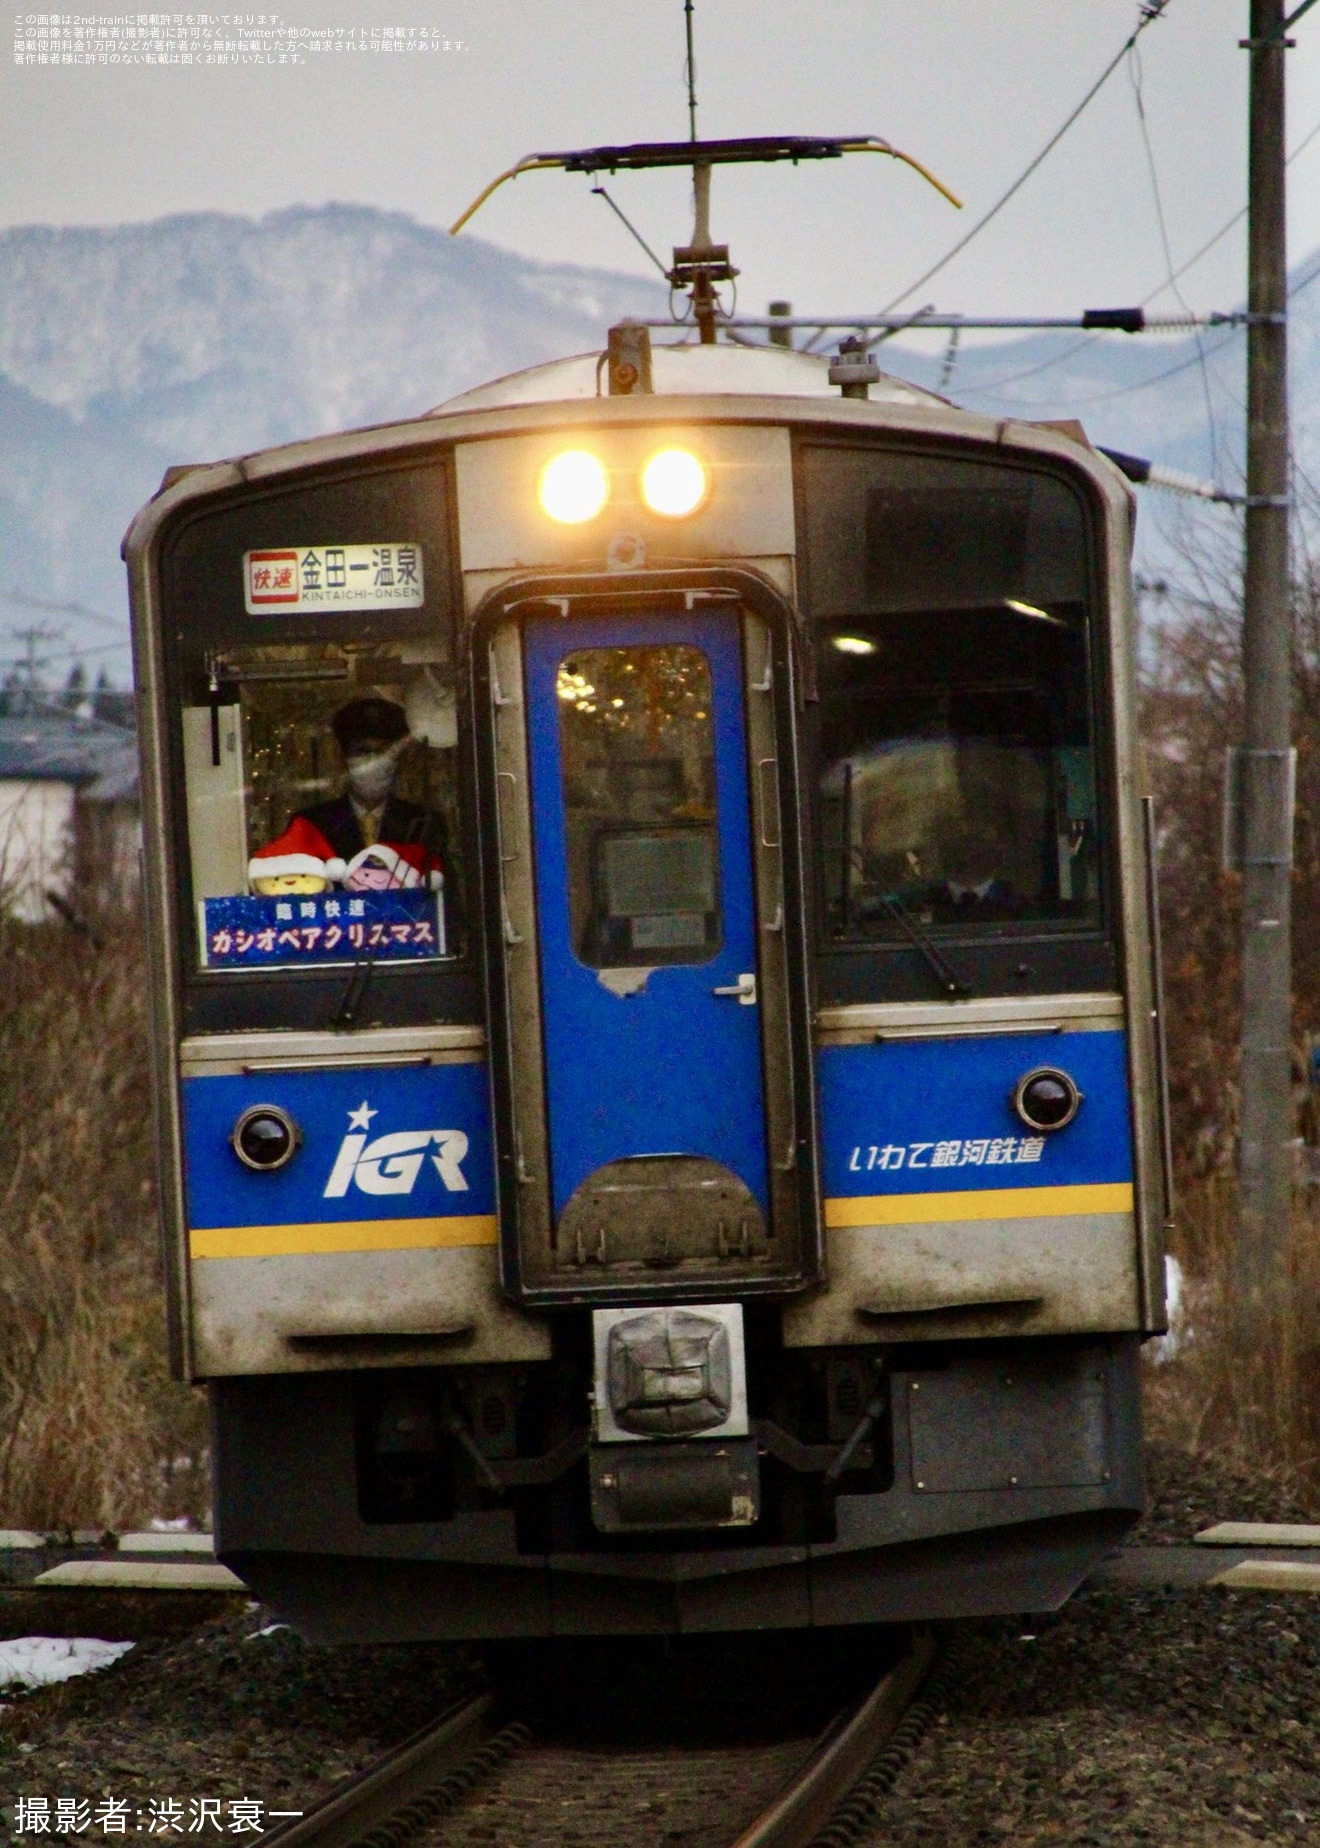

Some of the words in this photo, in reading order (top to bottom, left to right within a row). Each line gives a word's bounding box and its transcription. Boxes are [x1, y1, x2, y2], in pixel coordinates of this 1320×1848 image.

[253, 567, 293, 589] 快速
[301, 546, 419, 590] 金田一温泉
[302, 587, 420, 601] KINTAICHI-ONSEN
[849, 1136, 1046, 1171] いわて銀河鉄道
